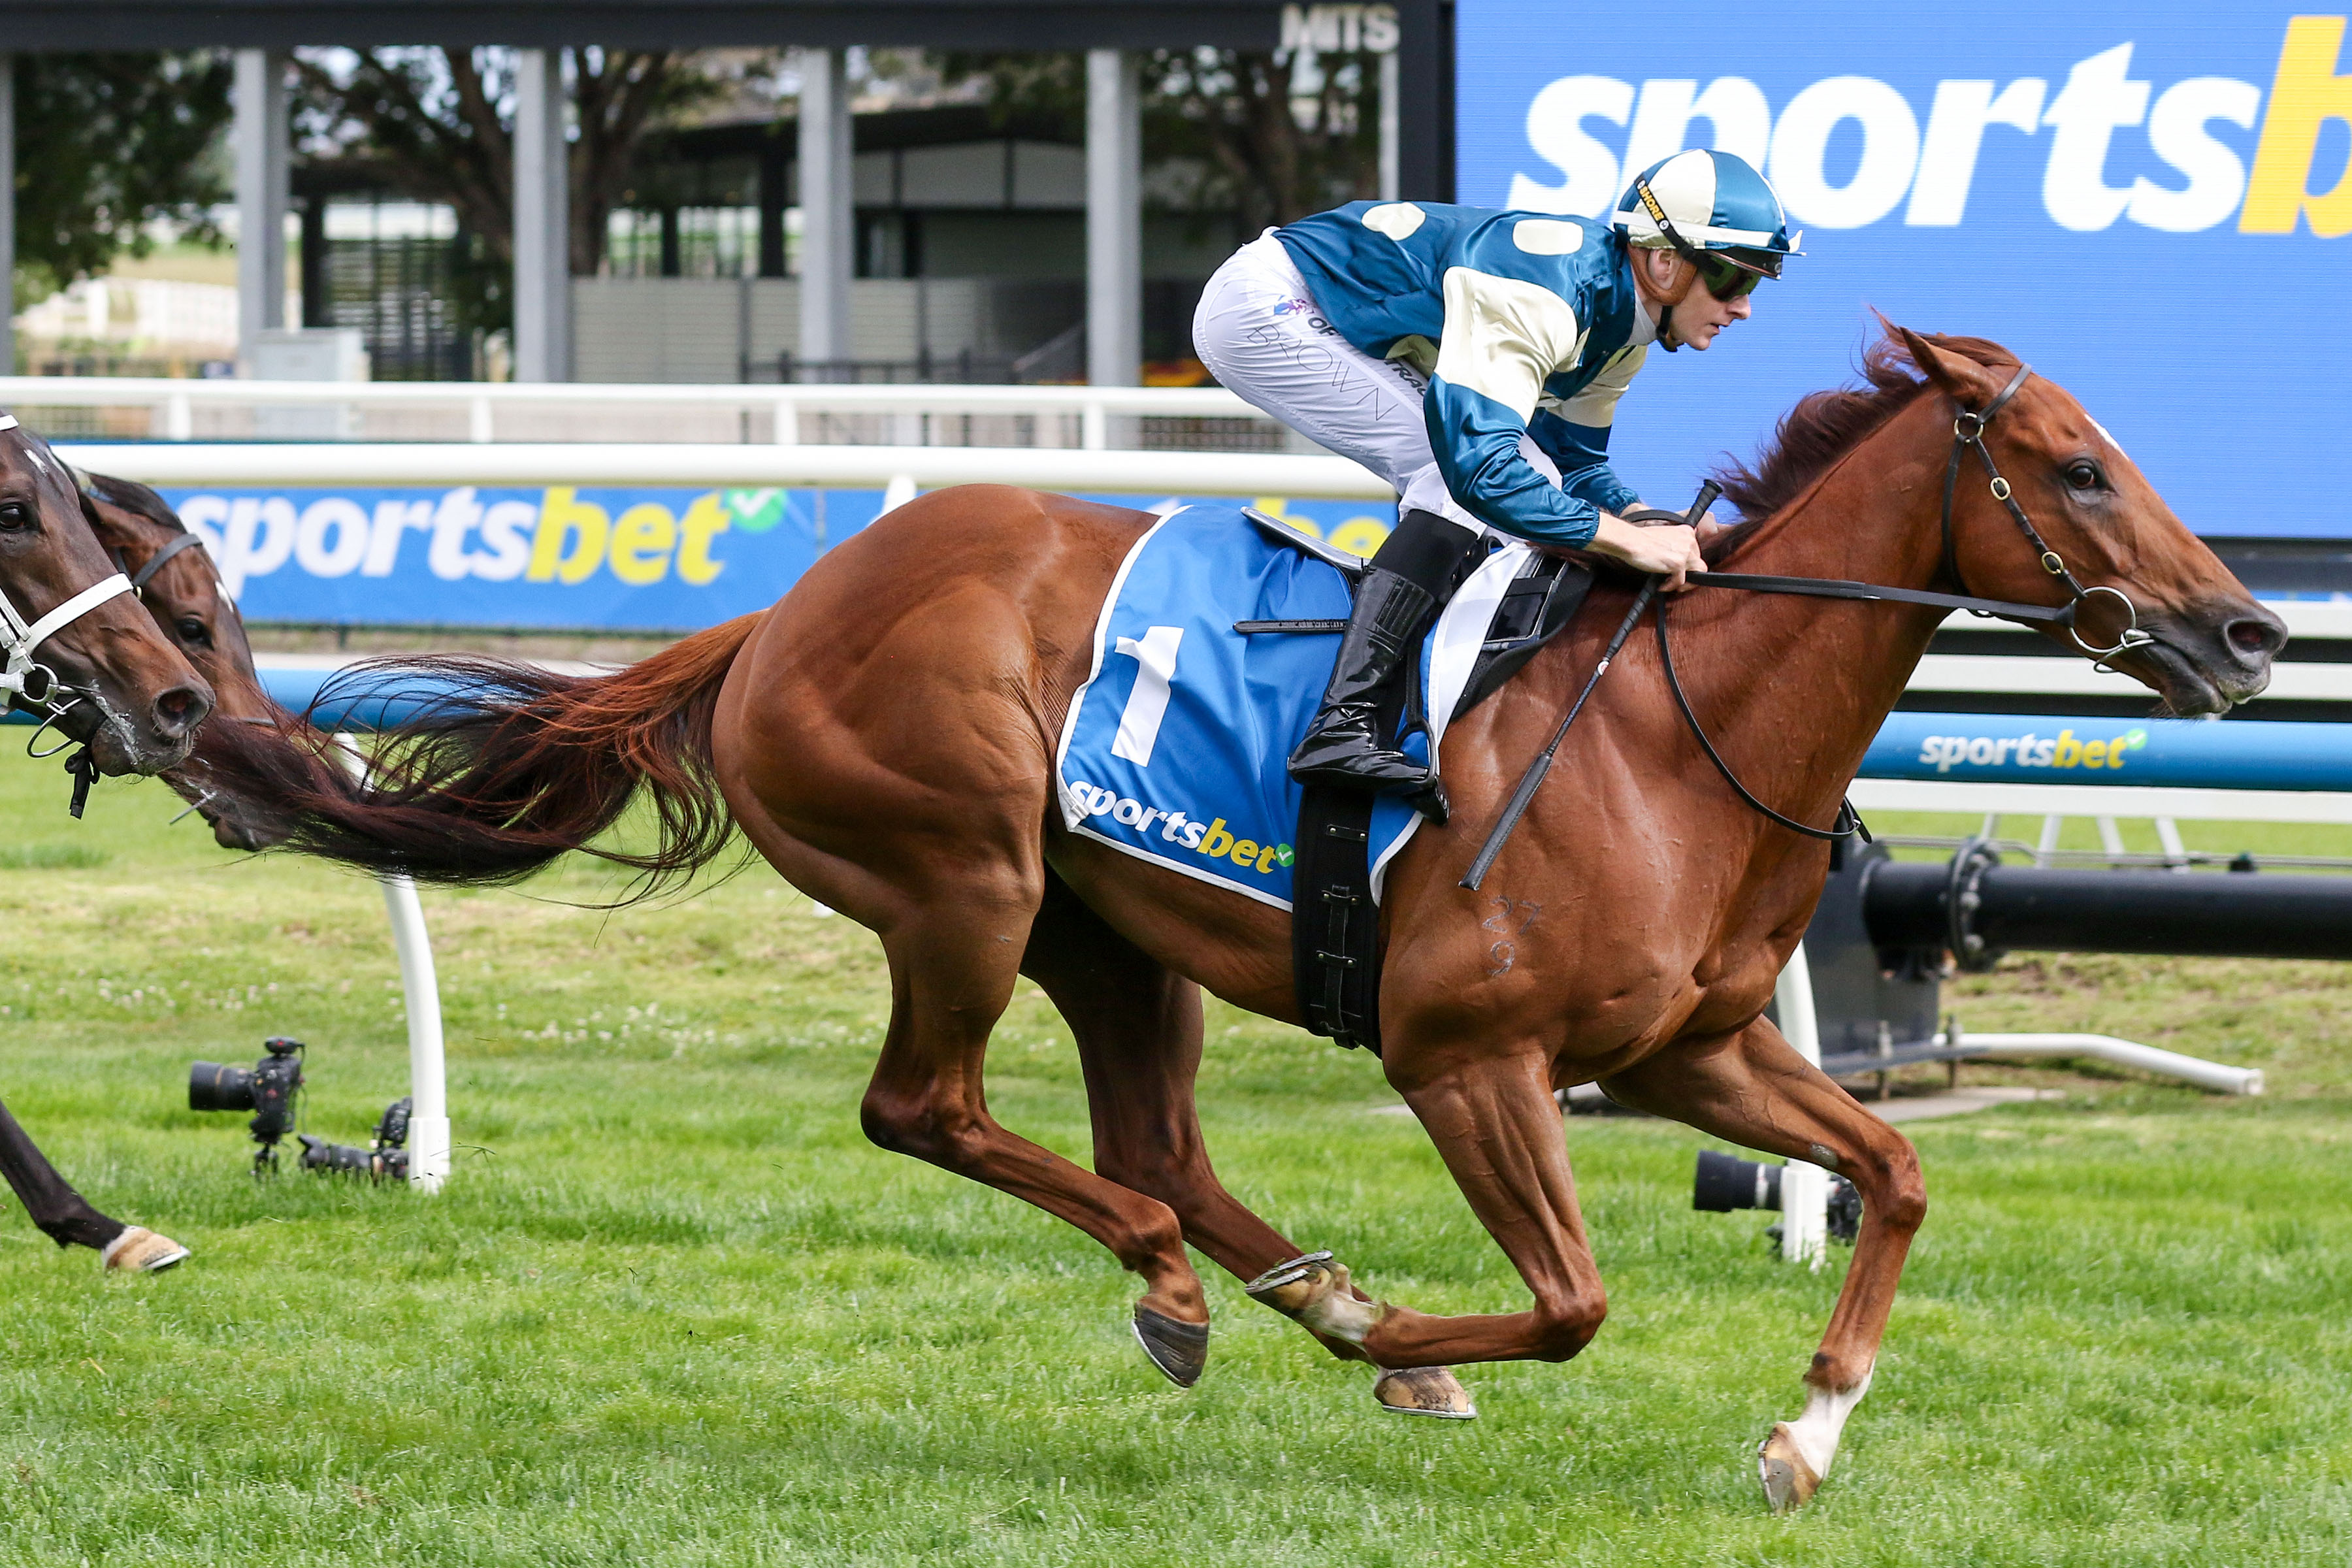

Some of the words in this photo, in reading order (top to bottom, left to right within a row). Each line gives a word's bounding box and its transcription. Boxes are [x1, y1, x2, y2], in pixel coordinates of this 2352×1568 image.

[1281, 3, 1400, 52] MITS
[1639, 186, 1665, 221] SHORE
[178, 485, 730, 600] sportsbet
[1111, 626, 1184, 768] 1
[1919, 729, 2127, 772] sportsbet
[1070, 781, 1277, 874] sportsbet
[1482, 895, 1541, 934] 27
[1487, 940, 1515, 977] 9
